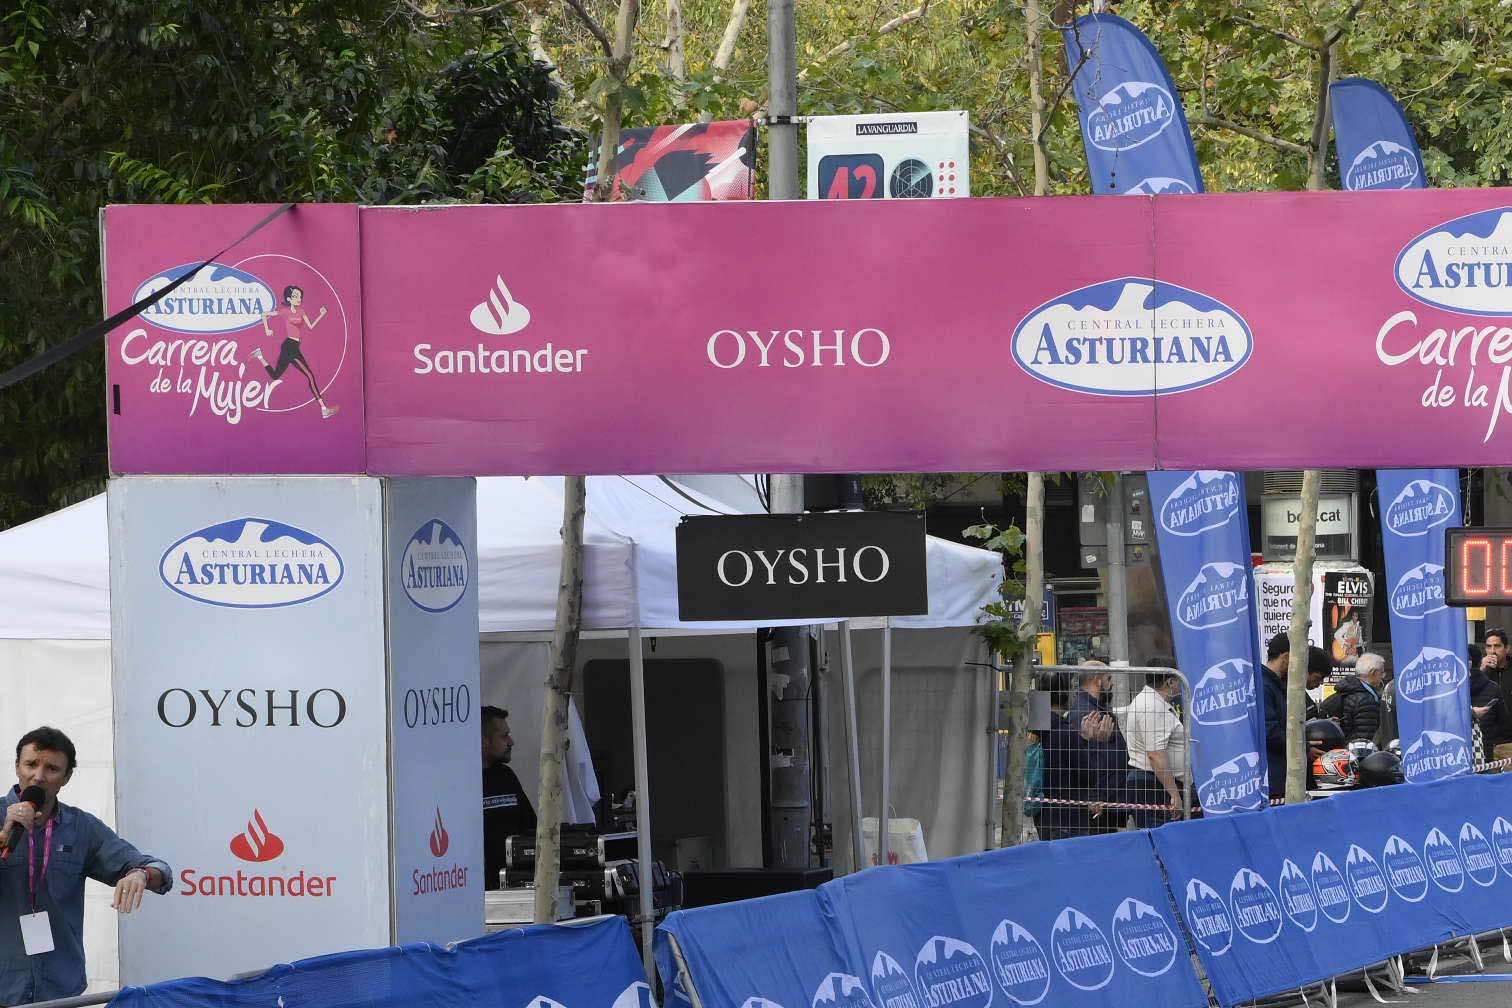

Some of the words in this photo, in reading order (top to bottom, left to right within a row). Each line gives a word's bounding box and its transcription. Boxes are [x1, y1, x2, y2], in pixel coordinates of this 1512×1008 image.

[867, 123, 916, 134] VANGUARDIA
[145, 289, 265, 315] ASTURIANA
[214, 286, 260, 294] LECHERA
[1067, 319, 1142, 331] CENTRAL
[1150, 317, 1226, 330] LECHERA
[121, 328, 238, 366] Carrera
[413, 342, 588, 374] Santander
[706, 328, 891, 368] OYSHO
[1030, 323, 1233, 366] ASTURIANA
[150, 368, 172, 393] de
[176, 366, 192, 393] la
[189, 362, 283, 424] Mujer
[1421, 369, 1456, 406] de
[1465, 367, 1488, 406] la
[174, 551, 329, 585] ASTURIANA
[202, 550, 261, 559] CENTRAL
[265, 549, 325, 558] LECHERA
[717, 545, 890, 587] OYSHO
[407, 554, 464, 589] ASTURIANA
[1338, 581, 1368, 594] ELVIS
[1263, 598, 1279, 611] que
[1264, 610, 1292, 625] quiere
[156, 687, 347, 728] OYSHO
[404, 684, 471, 728] OYSHO
[181, 868, 336, 897] Santander
[413, 862, 469, 896] Santander
[920, 970, 991, 1008] ASTURIANA
